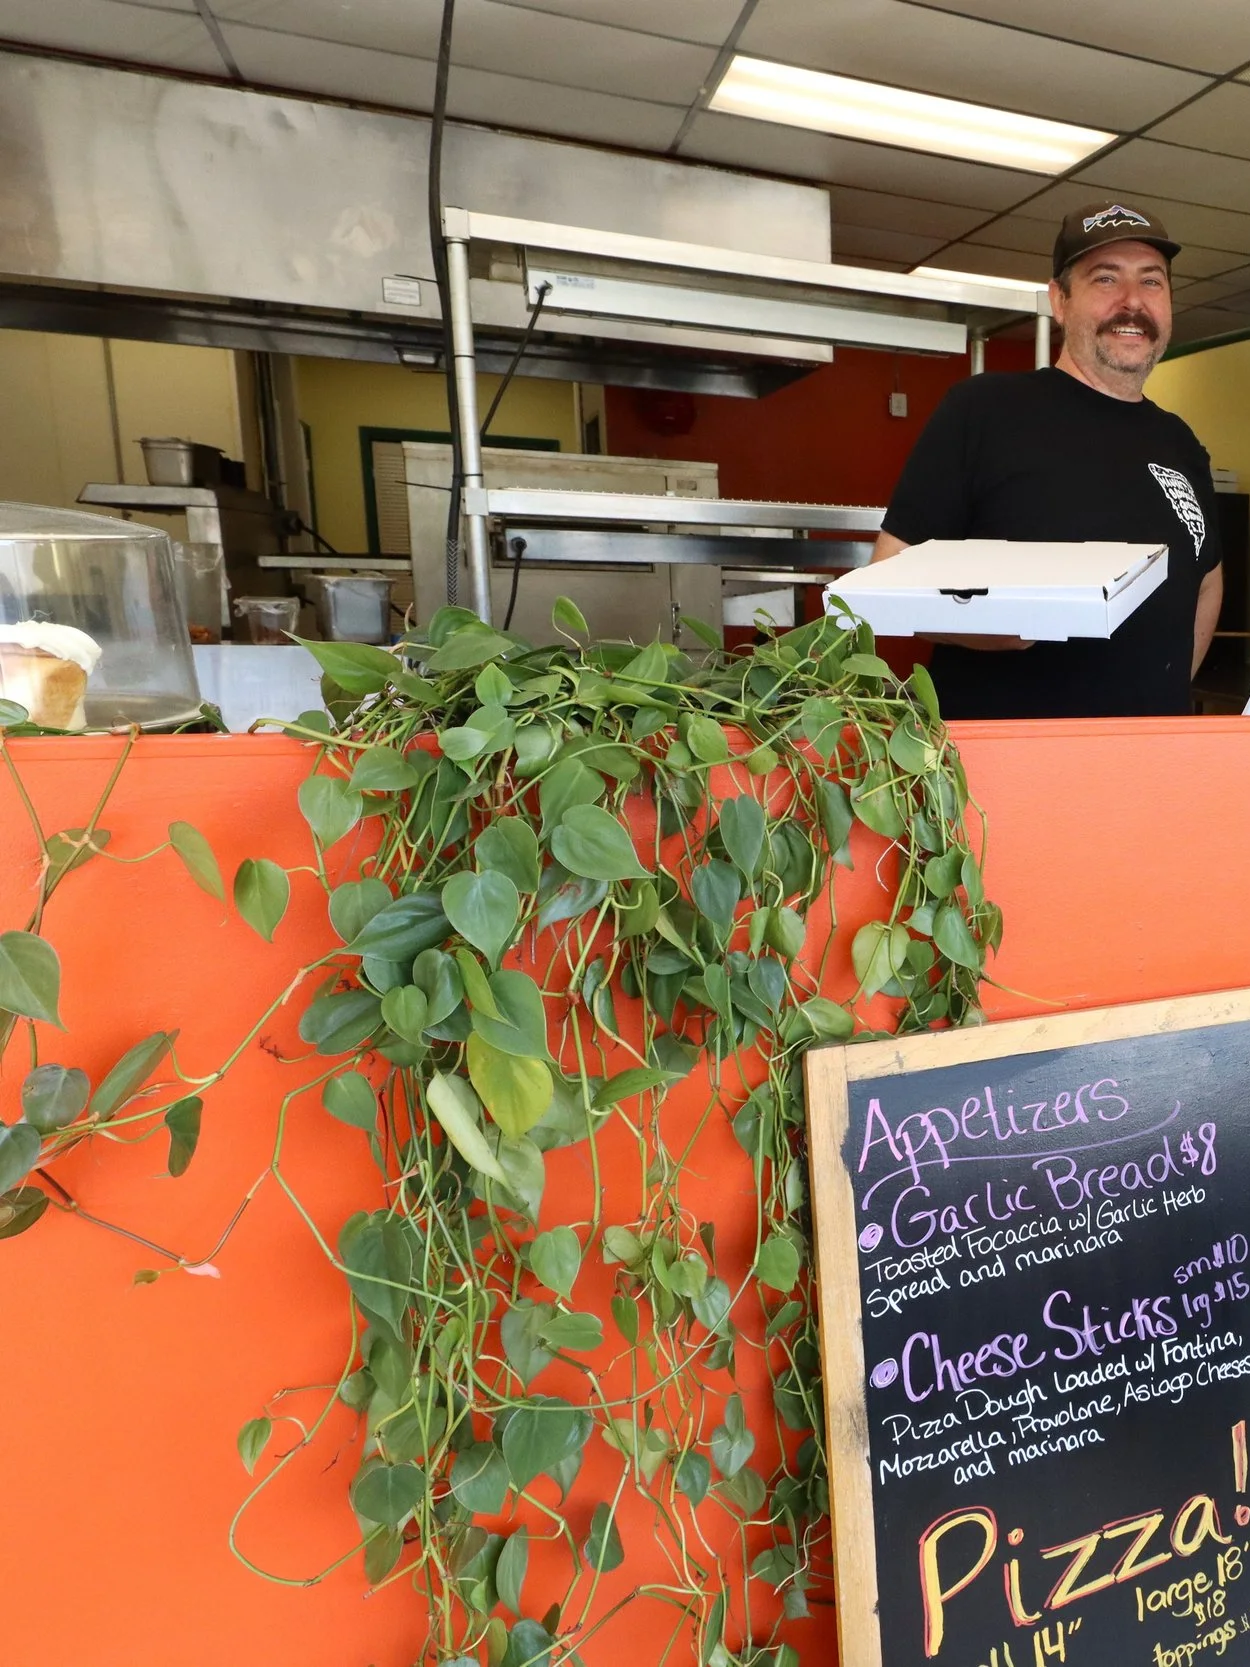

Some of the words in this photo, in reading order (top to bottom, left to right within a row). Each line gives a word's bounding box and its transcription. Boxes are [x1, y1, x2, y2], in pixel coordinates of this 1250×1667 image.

[858, 1078, 1129, 1184] Appetizers
[865, 1241, 962, 1283] Toasted
[961, 1217, 1062, 1259] Focaccia
[1068, 1204, 1091, 1238] w/
[1095, 1197, 1158, 1231] Garlic
[1163, 1185, 1207, 1216] Herb
[890, 1179, 1036, 1248] Garlic
[1033, 1135, 1185, 1211] Bread
[866, 1274, 951, 1318] Spread
[960, 1255, 1006, 1287] and
[1015, 1230, 1123, 1269] marinara
[1214, 1271, 1250, 1303] $15
[882, 1413, 962, 1445] Pizza
[956, 1379, 1048, 1421] Dough
[1135, 1347, 1156, 1373] w/
[1163, 1331, 1243, 1367] Fontina,
[902, 1331, 1046, 1402] Cheese
[1042, 1290, 1178, 1361] Sticks
[879, 1424, 1017, 1485] Mozzarella,
[1011, 1393, 1122, 1439] Provolone,
[1123, 1374, 1194, 1407] Asiago
[954, 1456, 995, 1485] and
[1008, 1427, 1105, 1467] marinara
[1136, 1572, 1213, 1622] large
[1153, 1620, 1236, 1667] toppings
[1194, 1590, 1226, 1626] $18
